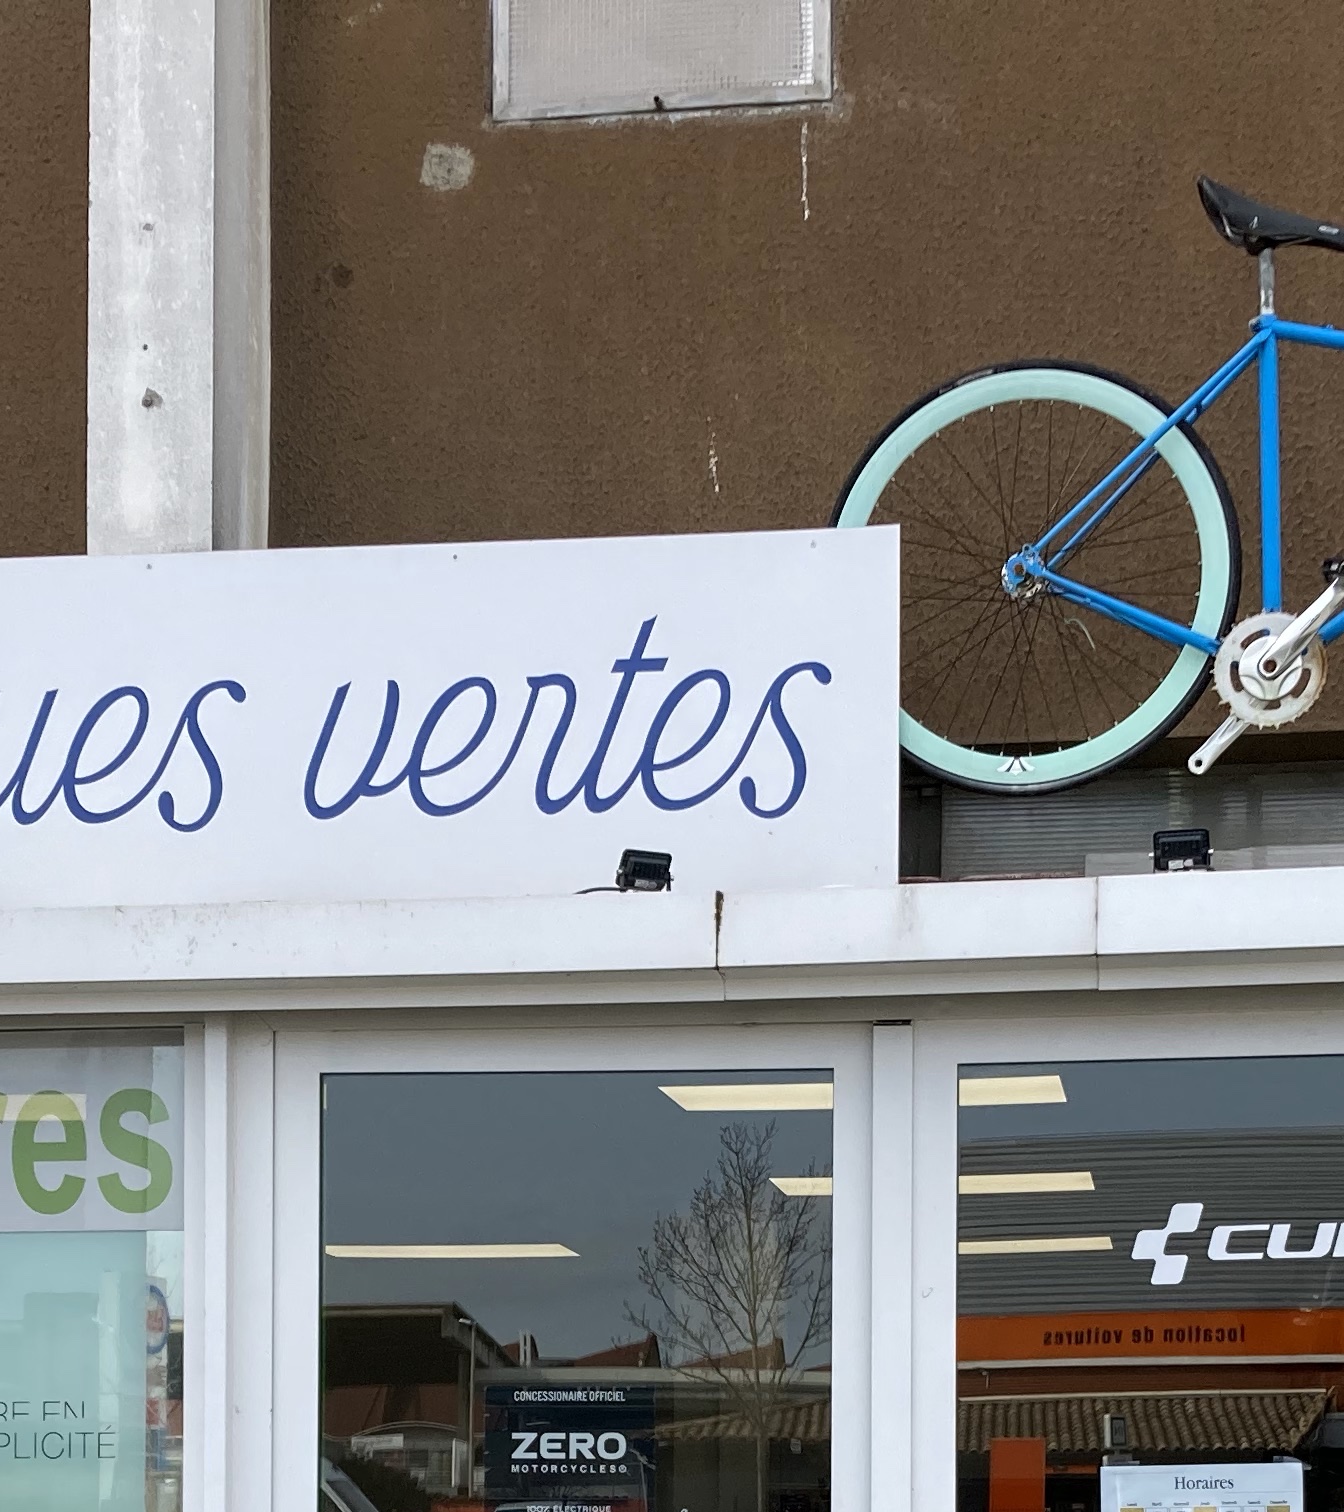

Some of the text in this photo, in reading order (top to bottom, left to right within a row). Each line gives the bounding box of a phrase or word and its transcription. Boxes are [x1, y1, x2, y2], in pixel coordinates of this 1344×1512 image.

[302, 616, 833, 820] vertes
[589, 1390, 625, 1402] OFFICIEL
[511, 1432, 627, 1460] ZERO
[1174, 1476, 1234, 1490] Horaires
